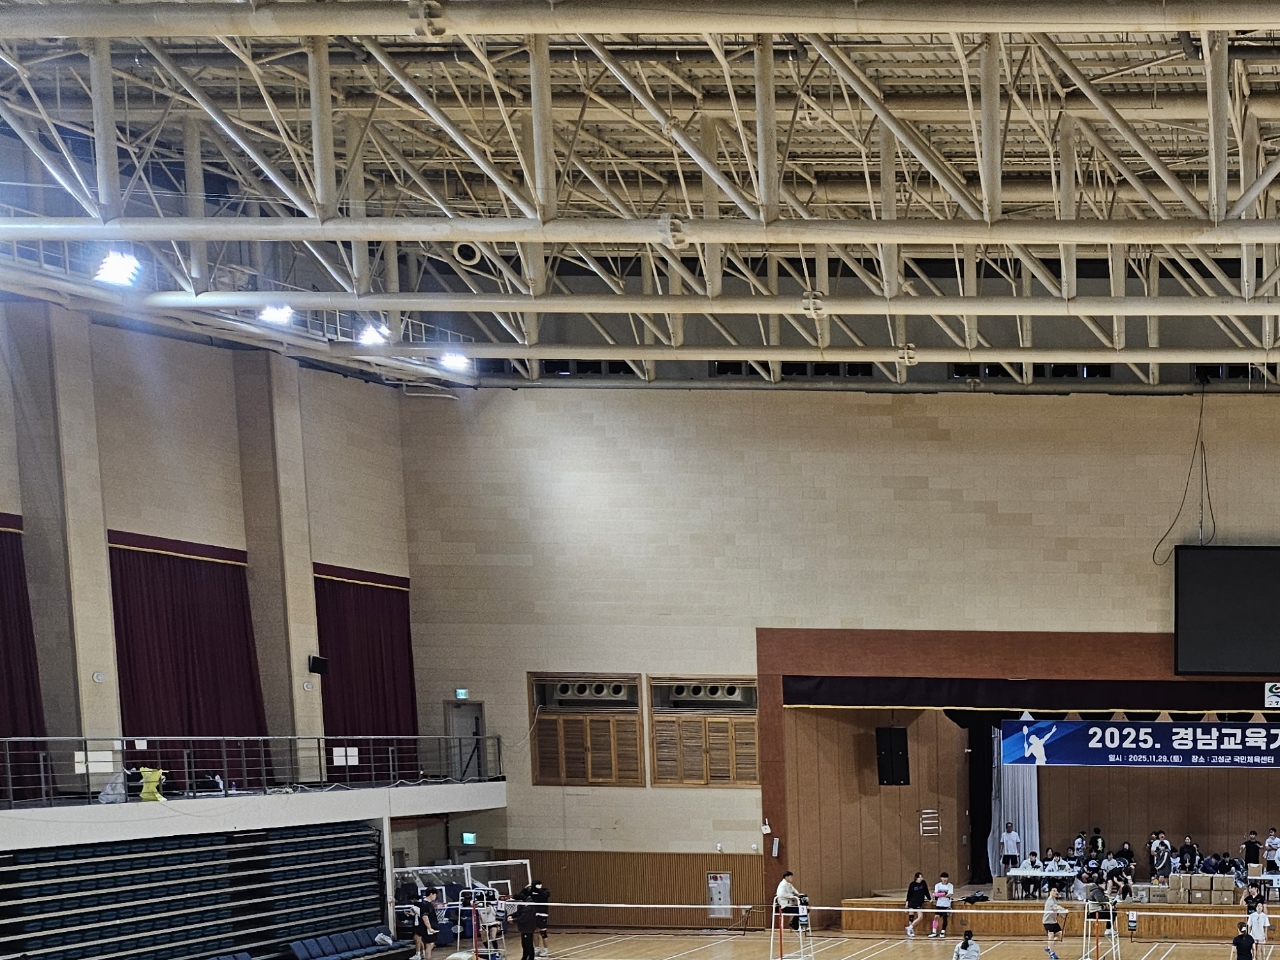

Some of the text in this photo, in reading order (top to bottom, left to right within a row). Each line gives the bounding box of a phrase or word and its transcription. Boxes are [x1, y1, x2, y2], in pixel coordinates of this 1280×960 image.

[1088, 727, 1161, 749] 2025.
[1108, 754, 1122, 762] 일시
[1233, 756, 1275, 764] 국민체육센터
